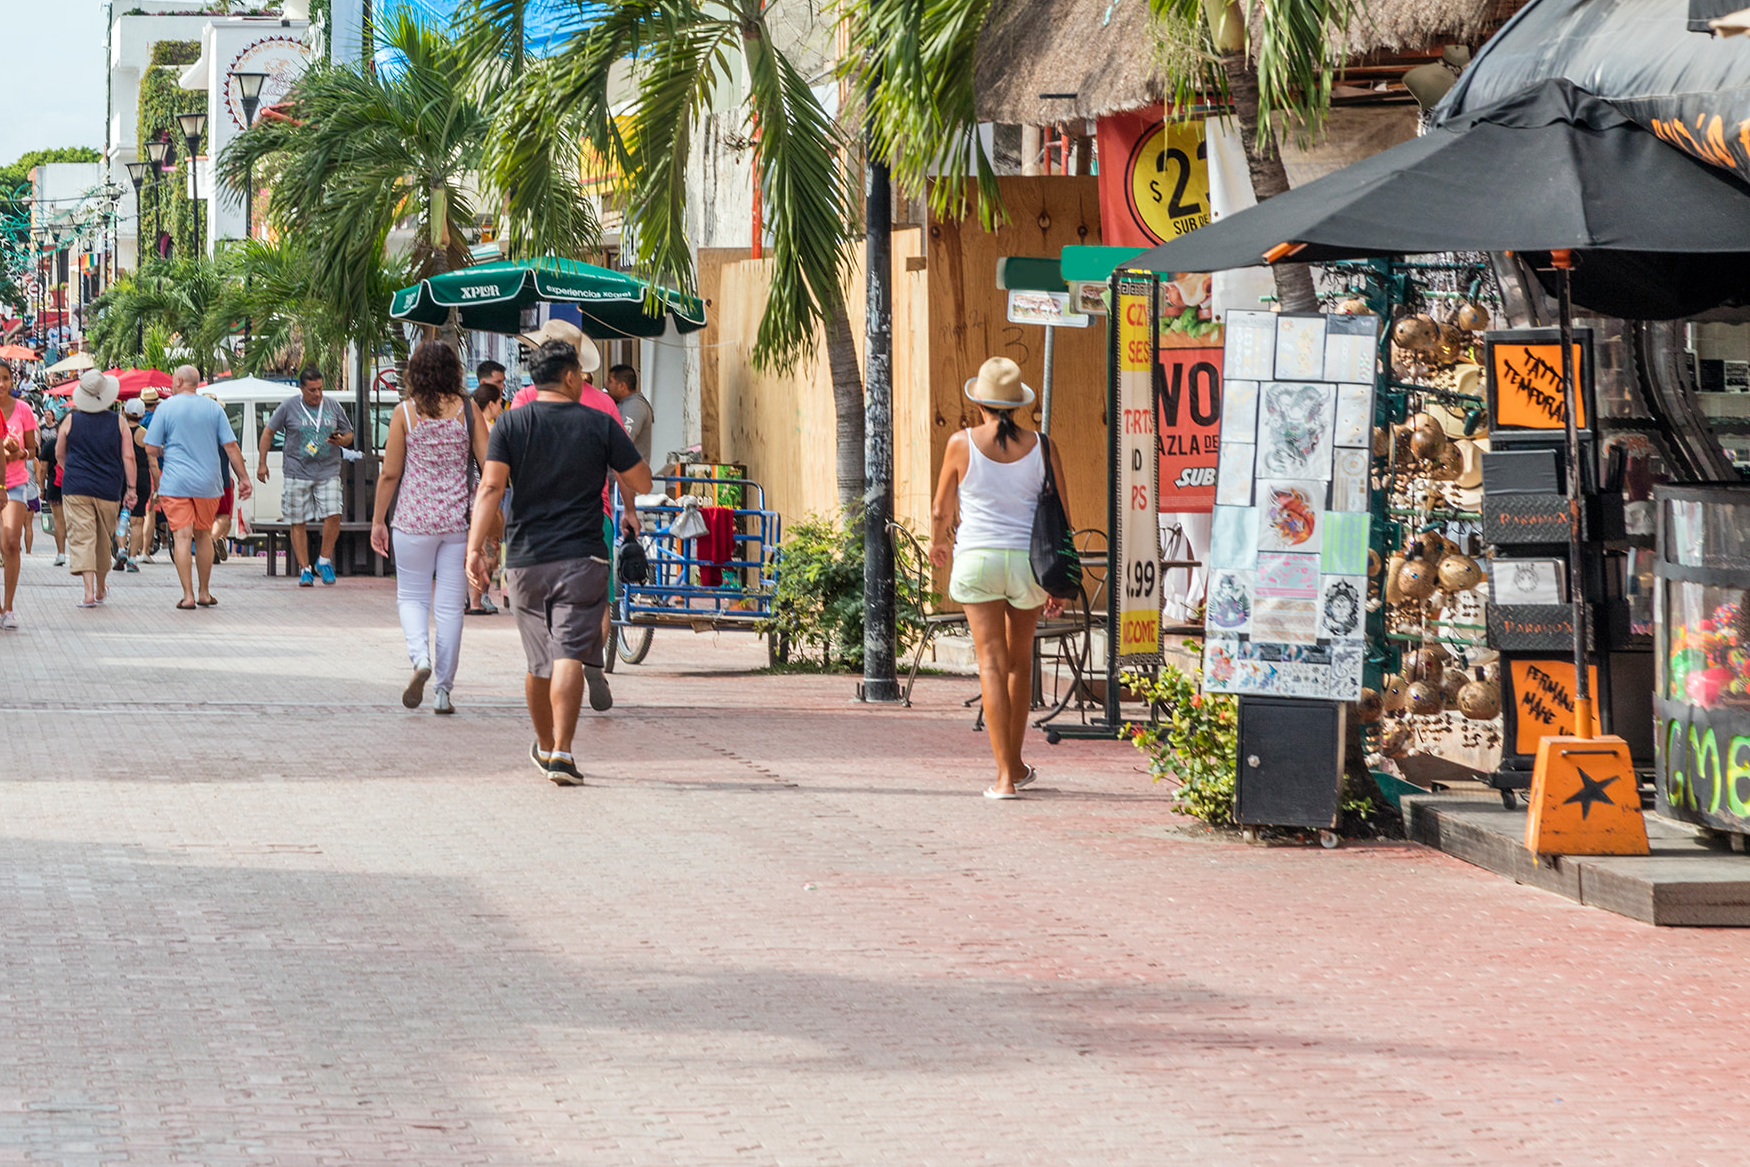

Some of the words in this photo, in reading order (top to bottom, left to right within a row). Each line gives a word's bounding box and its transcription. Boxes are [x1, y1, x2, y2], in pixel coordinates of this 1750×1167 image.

[1173, 218, 1198, 235] SUB
[460, 285, 500, 299] XPLOR
[546, 285, 602, 299] experiencias
